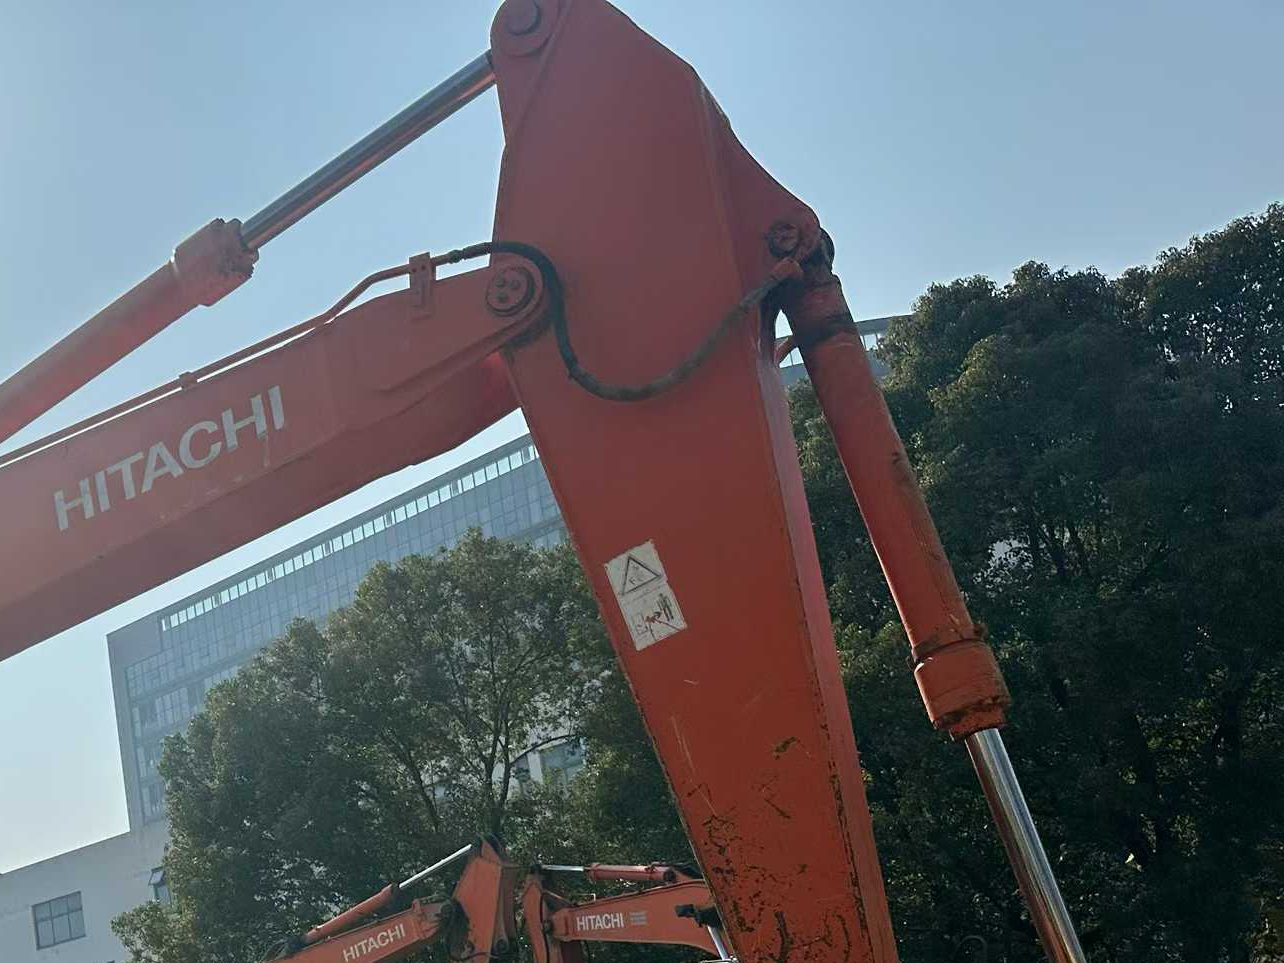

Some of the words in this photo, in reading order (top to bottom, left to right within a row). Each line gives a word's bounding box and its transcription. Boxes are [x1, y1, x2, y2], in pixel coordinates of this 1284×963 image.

[53, 385, 285, 531] HITACHI
[576, 912, 625, 932] HITACHI
[342, 923, 406, 963] HITACHI
